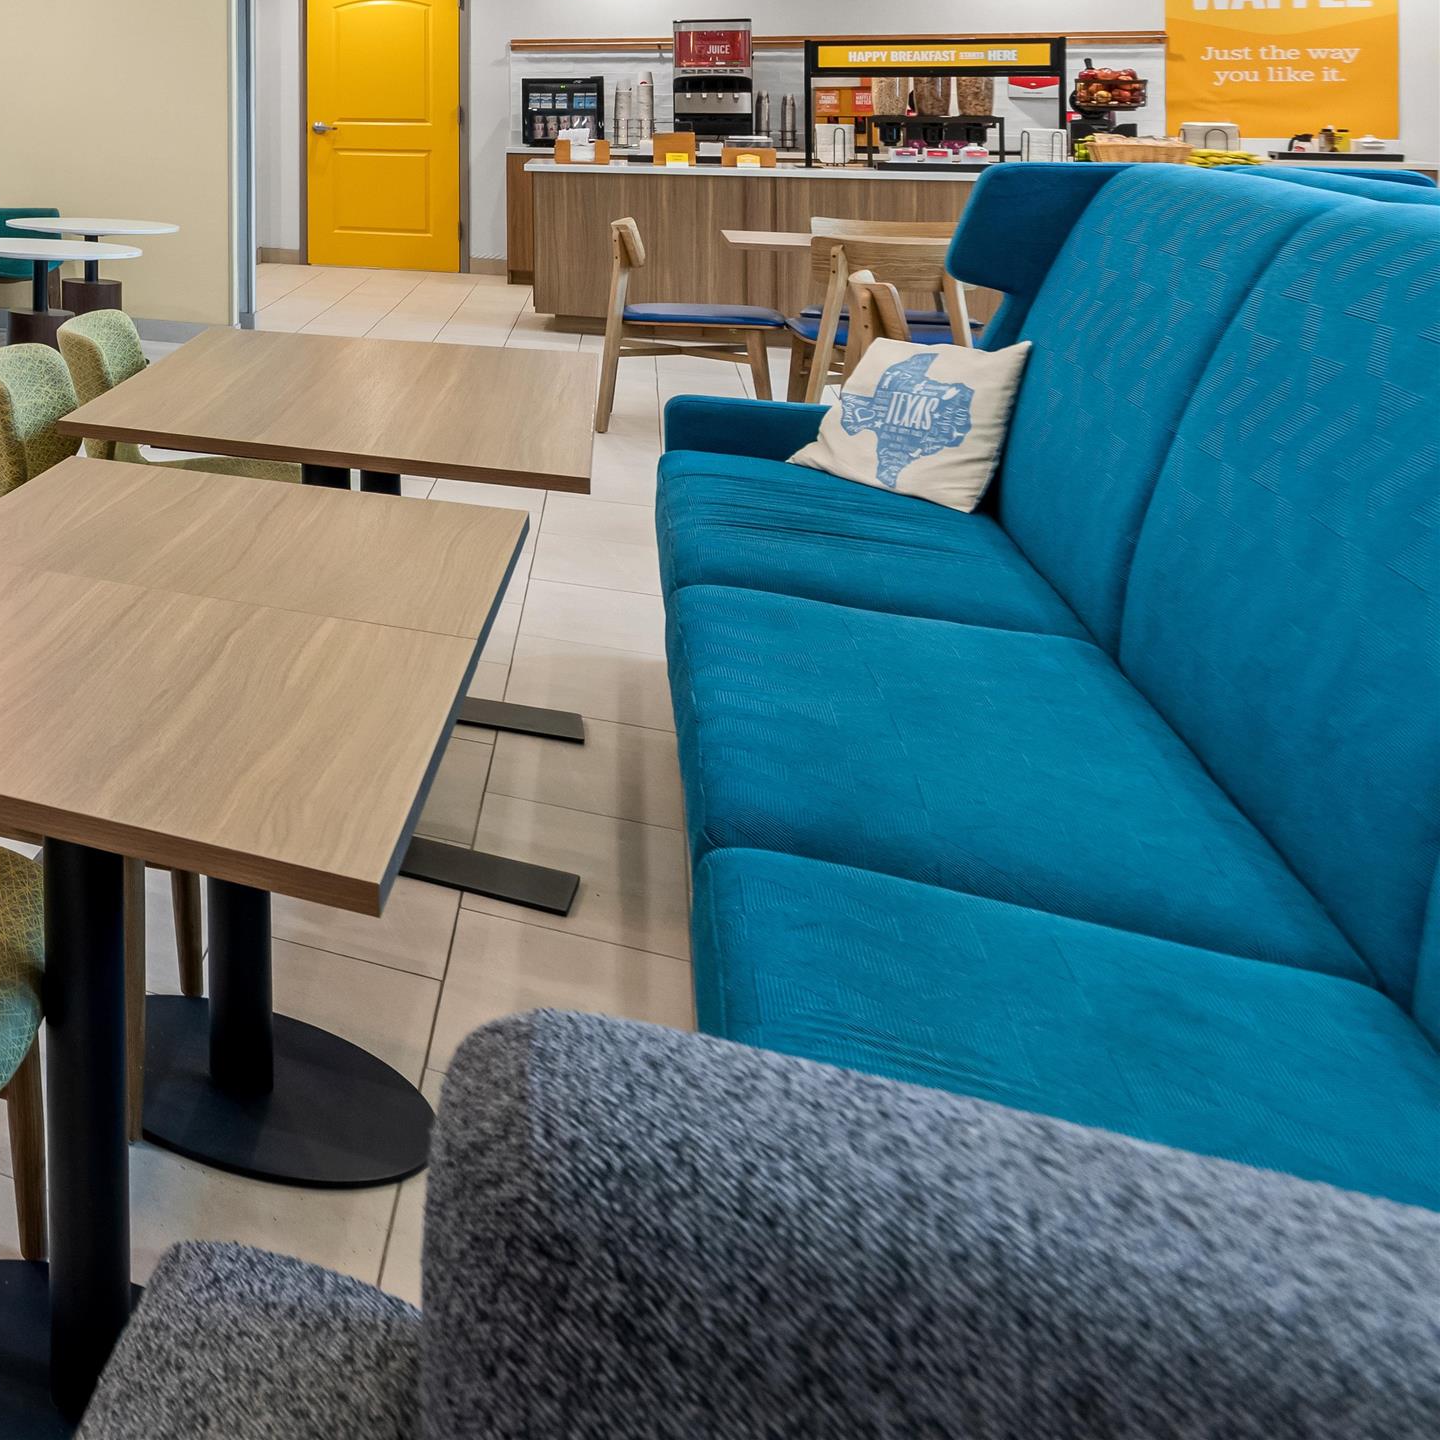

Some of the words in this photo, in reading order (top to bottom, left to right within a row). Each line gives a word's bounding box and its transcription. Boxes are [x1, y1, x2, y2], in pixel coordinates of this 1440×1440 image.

[707, 44, 731, 54] JUICE
[848, 51, 888, 62] HAPPY
[890, 50, 956, 62] BREAKFAST
[987, 49, 1018, 61] HERE
[1200, 46, 1252, 61] Just
[1259, 45, 1301, 61] the
[1306, 48, 1360, 63] way
[1213, 69, 1260, 86] you
[1267, 67, 1315, 82] like
[1321, 66, 1347, 82] it.
[886, 391, 940, 431] TEXAS
